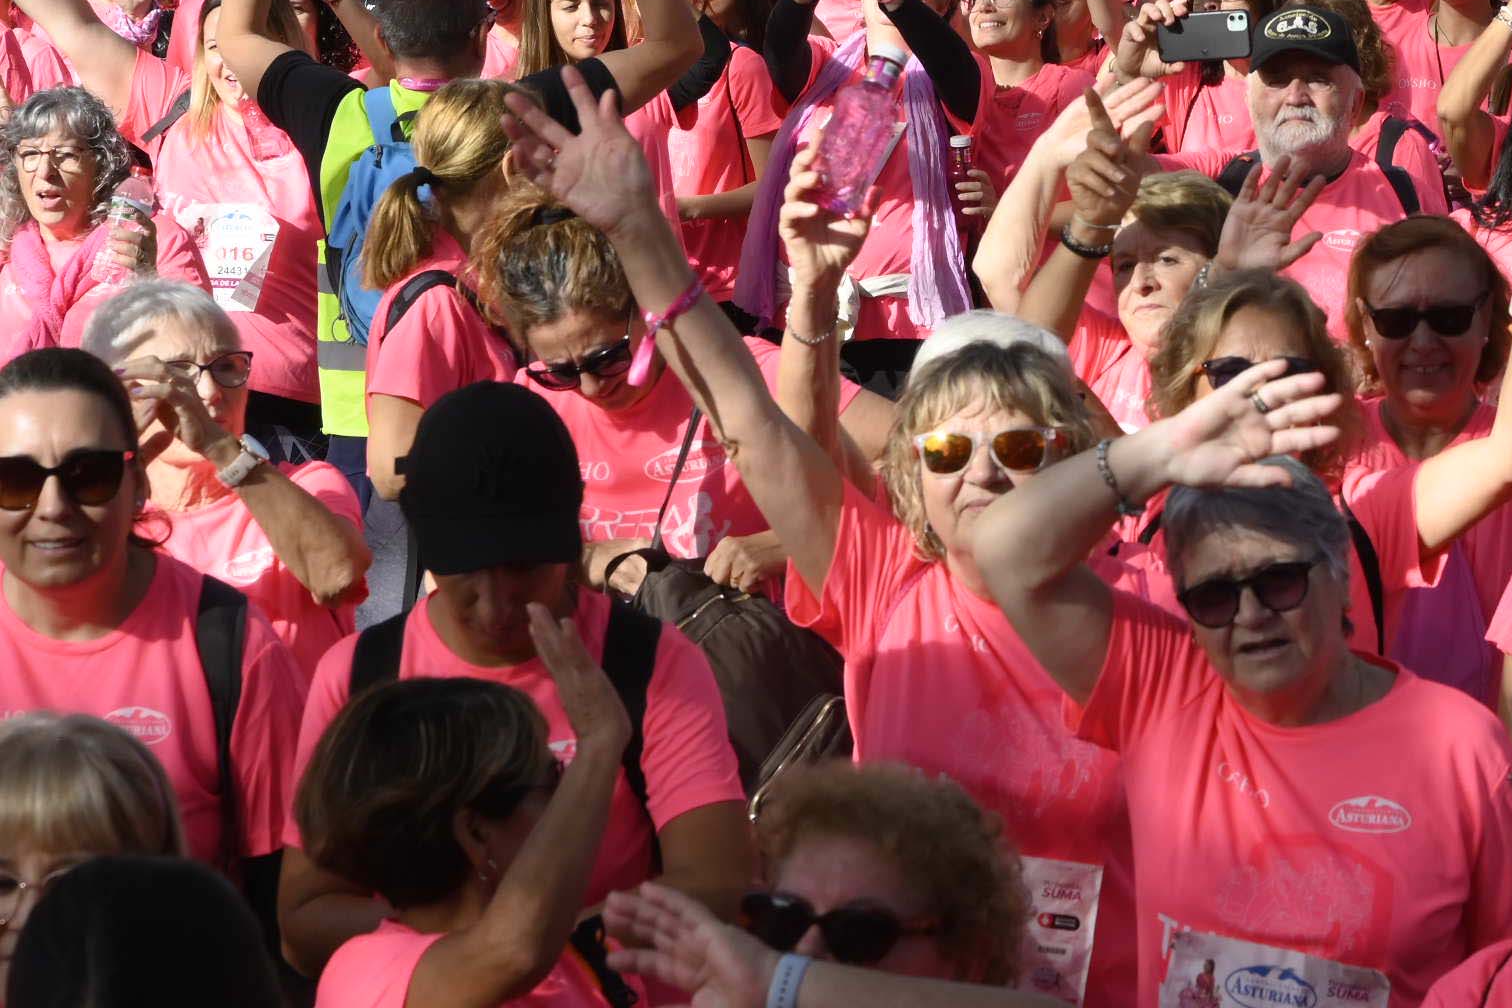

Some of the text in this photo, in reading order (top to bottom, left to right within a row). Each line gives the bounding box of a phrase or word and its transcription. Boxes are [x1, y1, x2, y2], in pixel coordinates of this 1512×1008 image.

[1337, 806, 1404, 827] ASTURIANA
[1041, 885, 1082, 902] SUMA
[1232, 975, 1309, 1008] ASTURIANA
[1328, 986, 1369, 1003] SUMA
